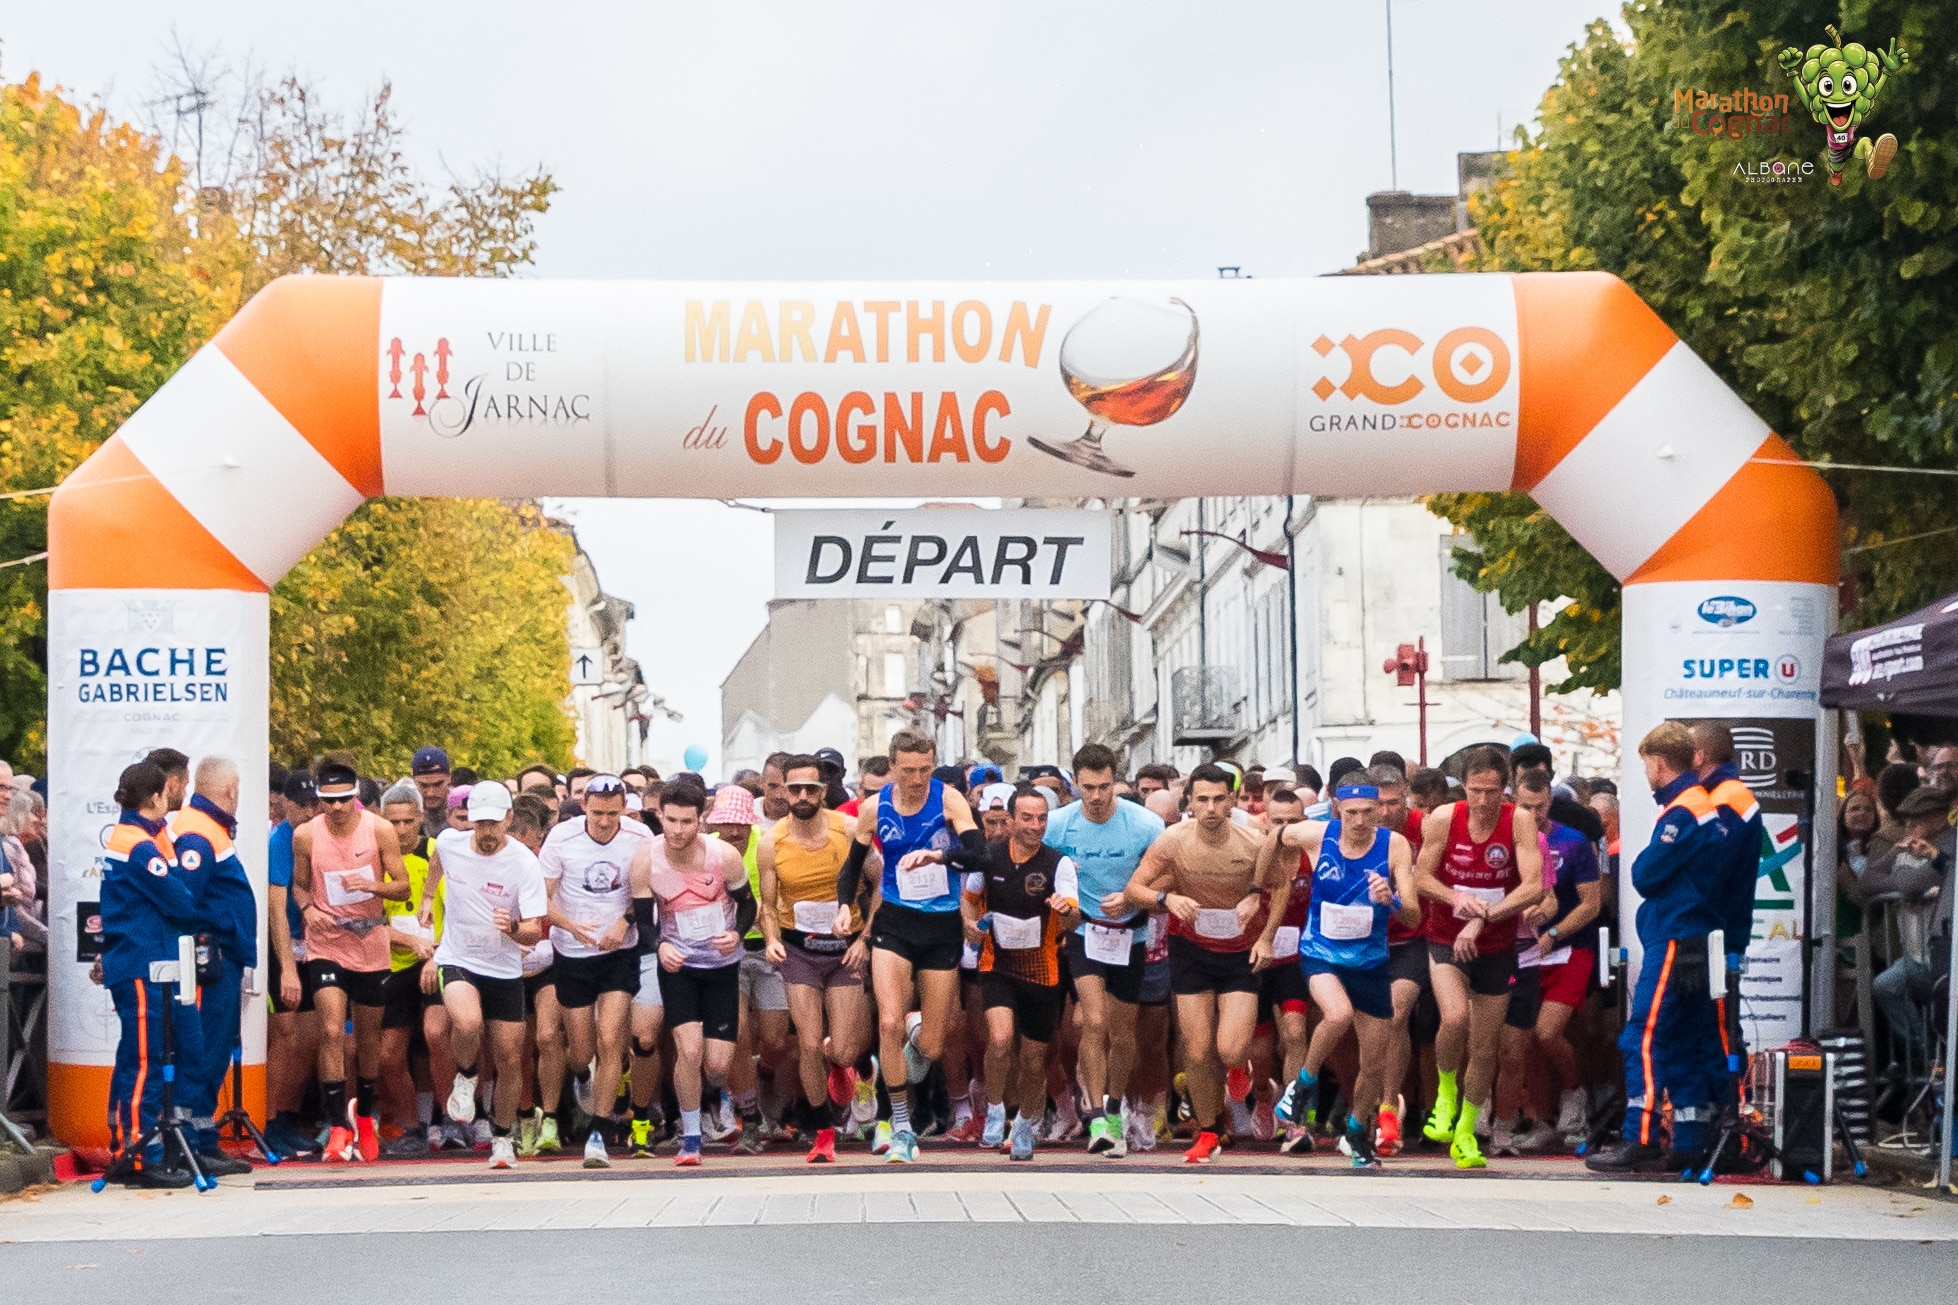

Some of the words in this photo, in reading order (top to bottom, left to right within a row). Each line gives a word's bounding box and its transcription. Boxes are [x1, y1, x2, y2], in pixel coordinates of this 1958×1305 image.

[488, 331, 558, 353] VILLE
[685, 300, 1052, 368] MARATHON
[505, 361, 536, 382] DE
[429, 373, 591, 438] JARNAC
[683, 404, 729, 451] du
[743, 390, 1012, 465] COGNAC
[1309, 413, 1397, 432] GRAND
[804, 520, 1085, 586] DÉPART
[79, 647, 228, 678] BACHE
[1682, 658, 1770, 680] SUPER
[1781, 662, 1796, 678] U
[78, 682, 228, 703] GABRIELSEN
[123, 712, 181, 723] COGNAC
[86, 801, 119, 816] L'Esp
